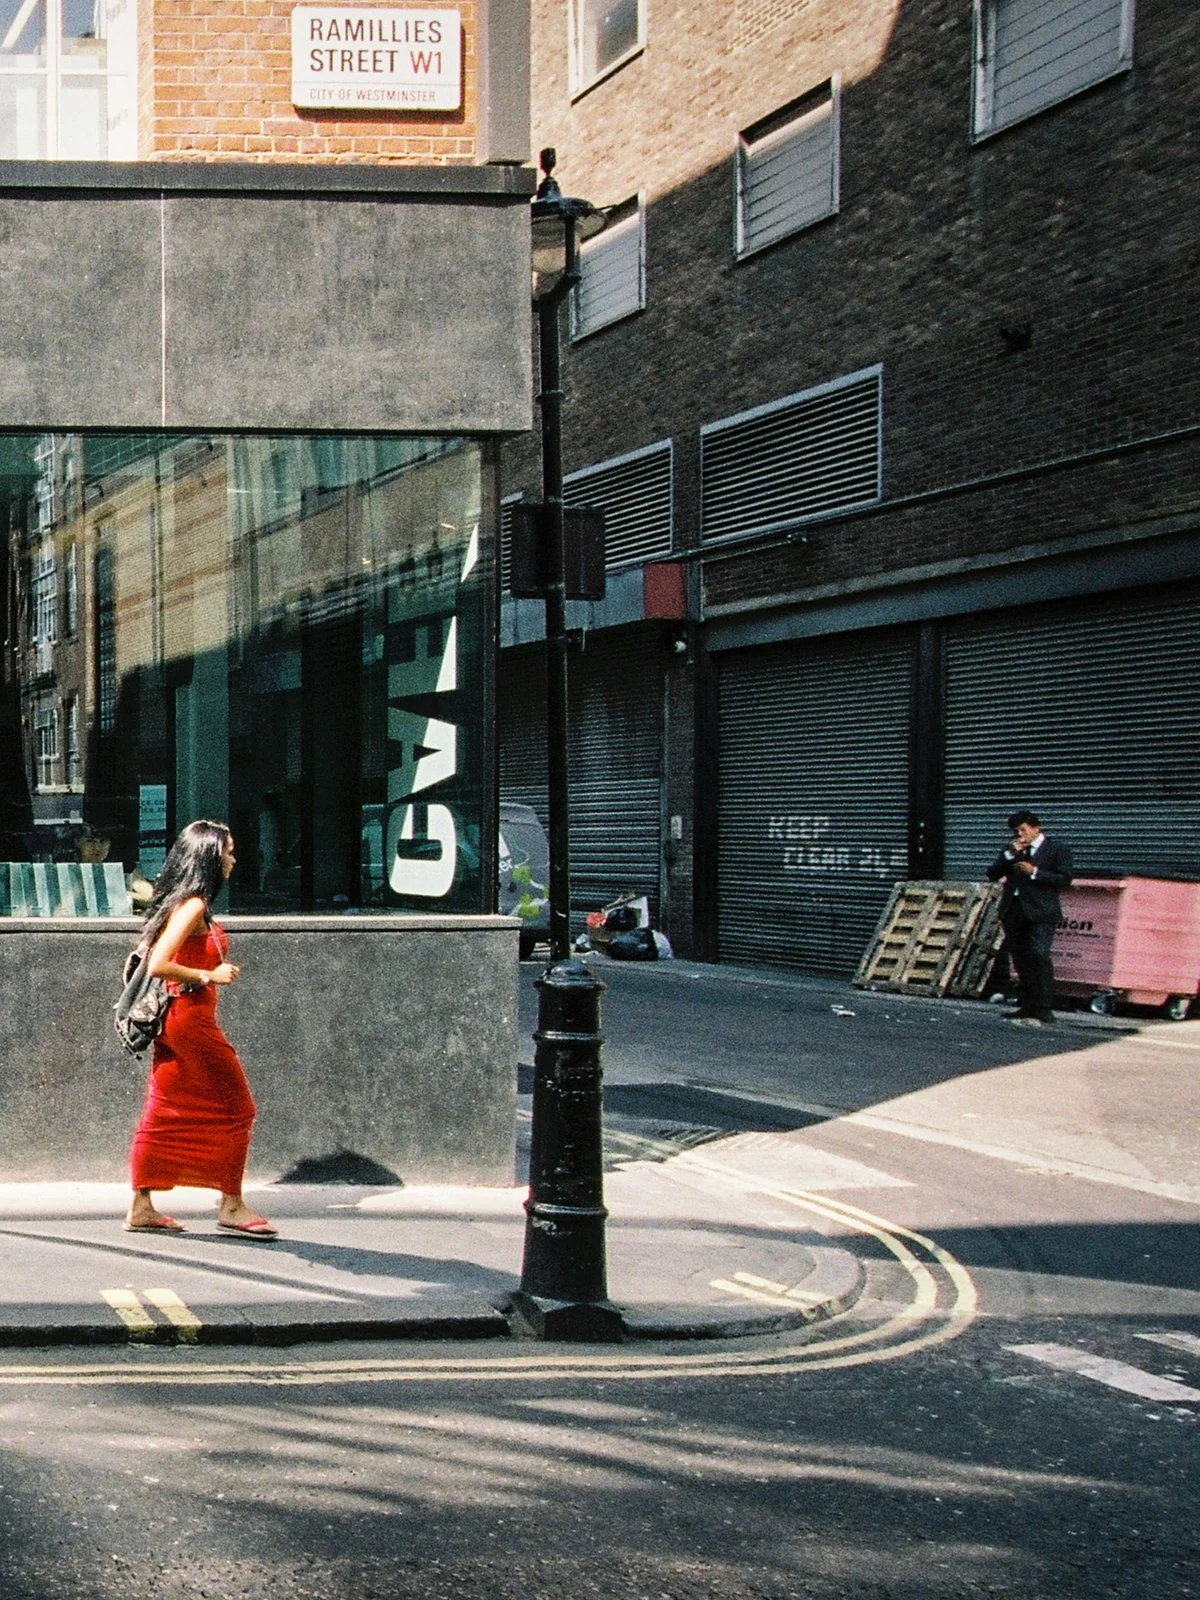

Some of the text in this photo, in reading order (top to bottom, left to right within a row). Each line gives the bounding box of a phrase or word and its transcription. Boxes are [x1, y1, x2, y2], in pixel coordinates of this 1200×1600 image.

[310, 18, 442, 43] RAMILLIES
[310, 49, 442, 74] STREET W1
[310, 89, 436, 101] CITY OF WESTMINSTER
[768, 816, 830, 839] KEEP
[783, 847, 850, 870] CLEAR
